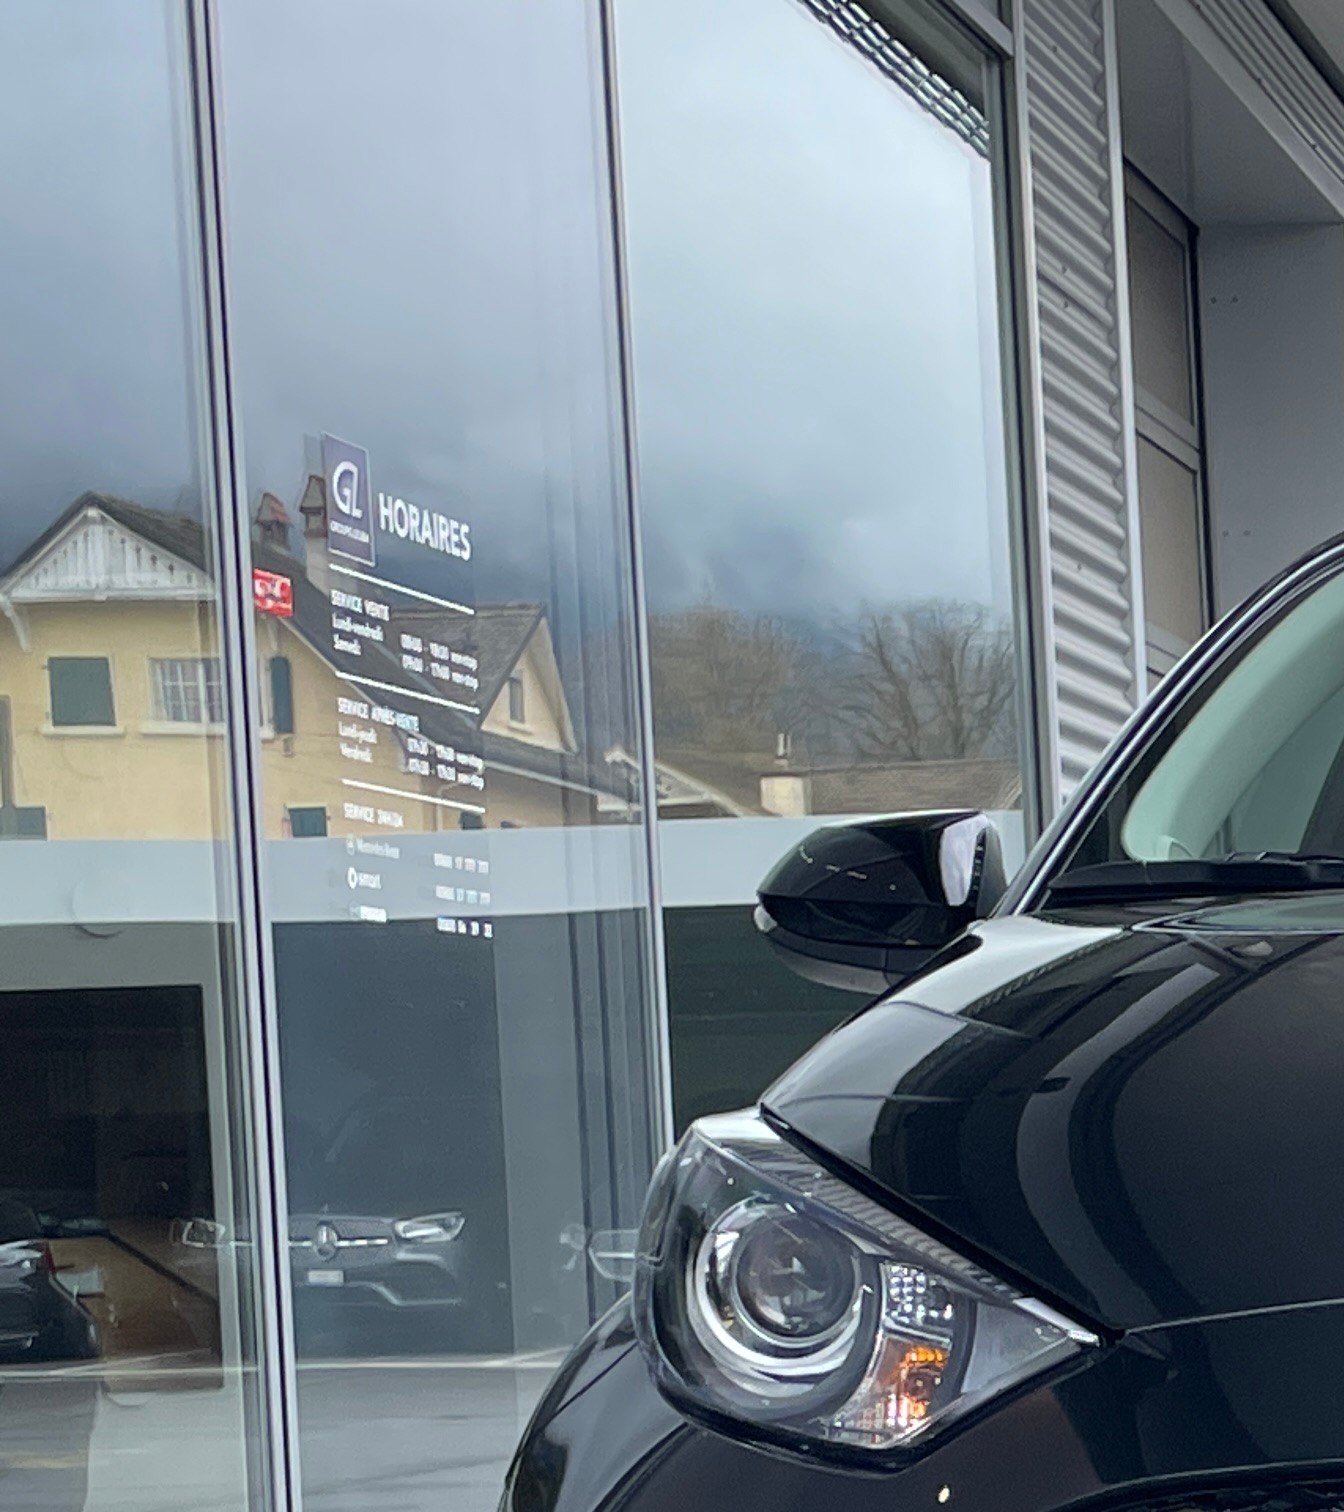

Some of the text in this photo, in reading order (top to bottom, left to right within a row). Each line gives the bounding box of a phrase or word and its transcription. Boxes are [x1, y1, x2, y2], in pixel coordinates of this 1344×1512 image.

[379, 492, 472, 561] HORAIRES
[331, 589, 363, 614] SERVICE
[337, 697, 370, 719] SERVICE
[344, 802, 376, 823] SERVICE
